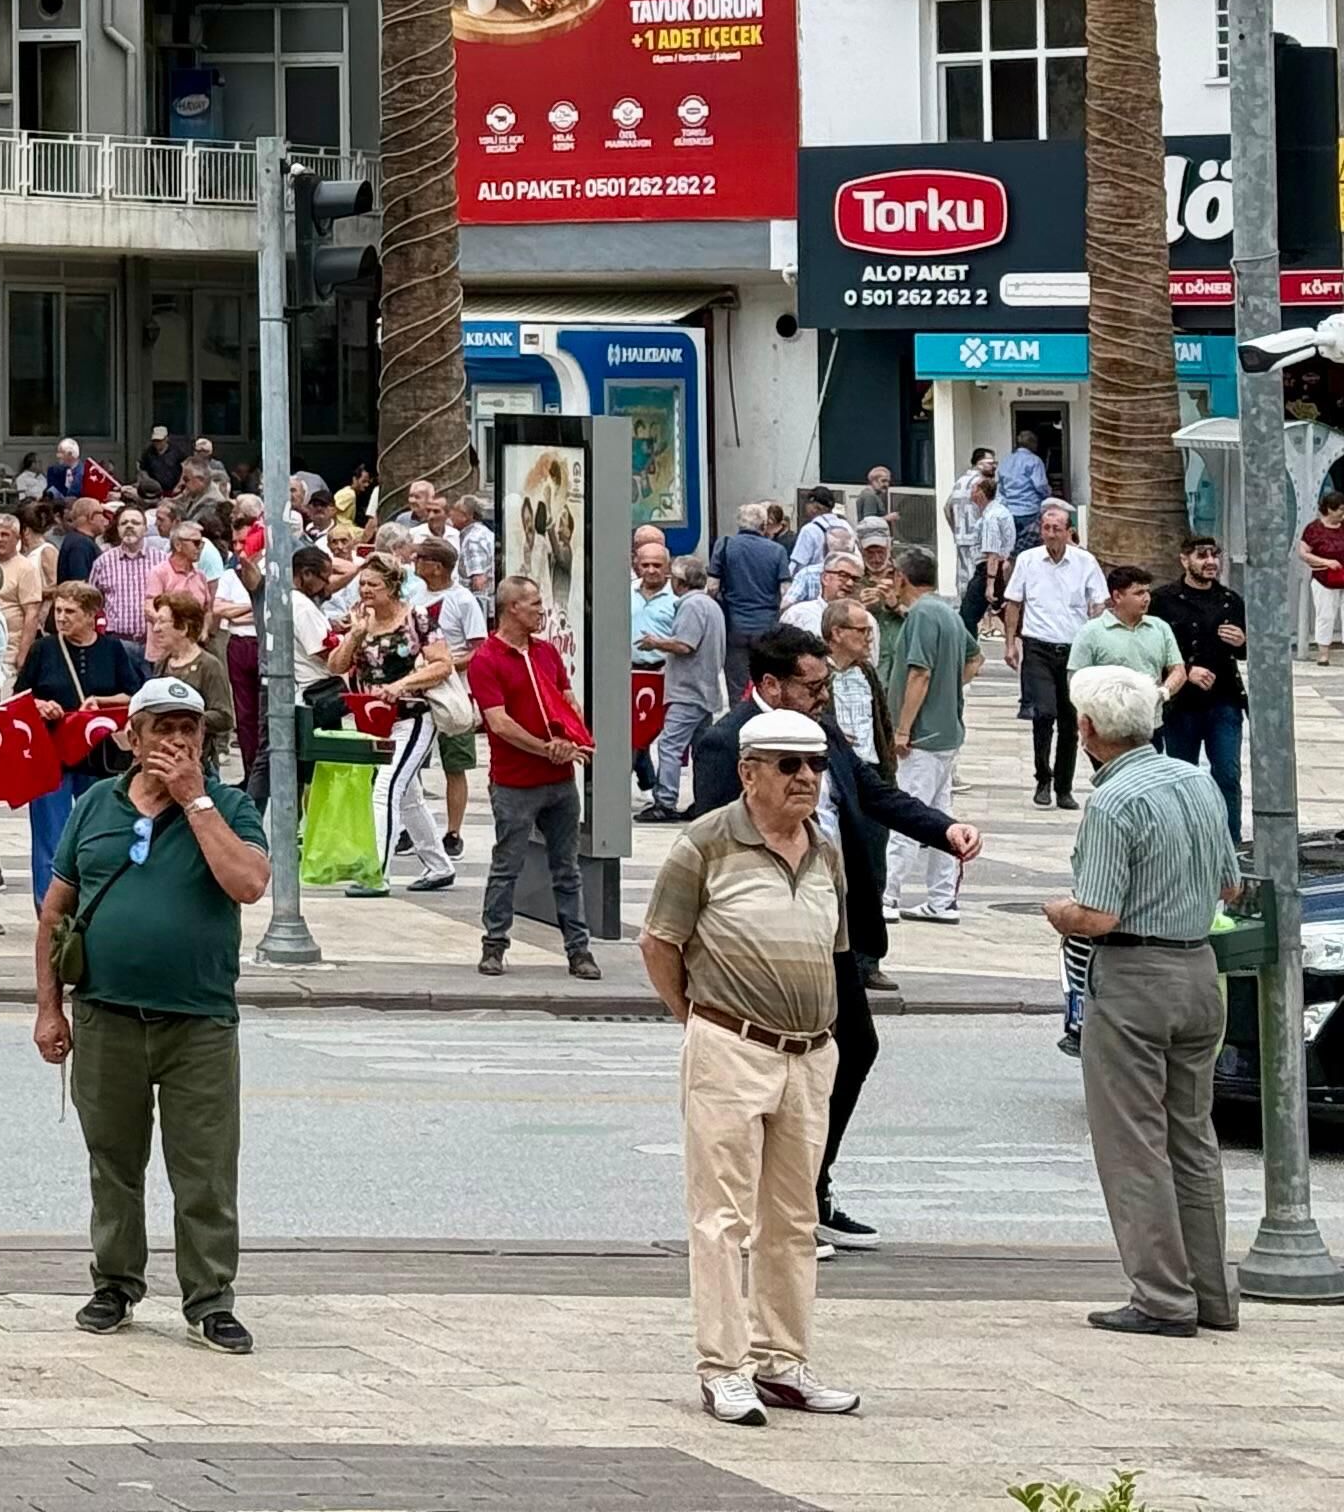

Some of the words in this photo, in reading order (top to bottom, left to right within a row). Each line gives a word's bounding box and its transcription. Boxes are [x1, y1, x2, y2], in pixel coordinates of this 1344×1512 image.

[658, 27, 702, 49] ADET
[478, 183, 514, 200] ALO
[585, 178, 627, 198] 0501
[628, 177, 663, 196] 262
[666, 176, 701, 195] 262
[703, 176, 716, 194] 2
[852, 187, 985, 232] Torku
[862, 265, 904, 282] ALO
[905, 264, 969, 282] PAKET
[1185, 279, 1232, 294] DÖNER
[844, 290, 858, 306] 0
[862, 290, 893, 305] 501
[897, 290, 932, 305] 262
[936, 289, 972, 305] 262
[975, 289, 988, 305] 2
[989, 340, 1040, 361] TAM
